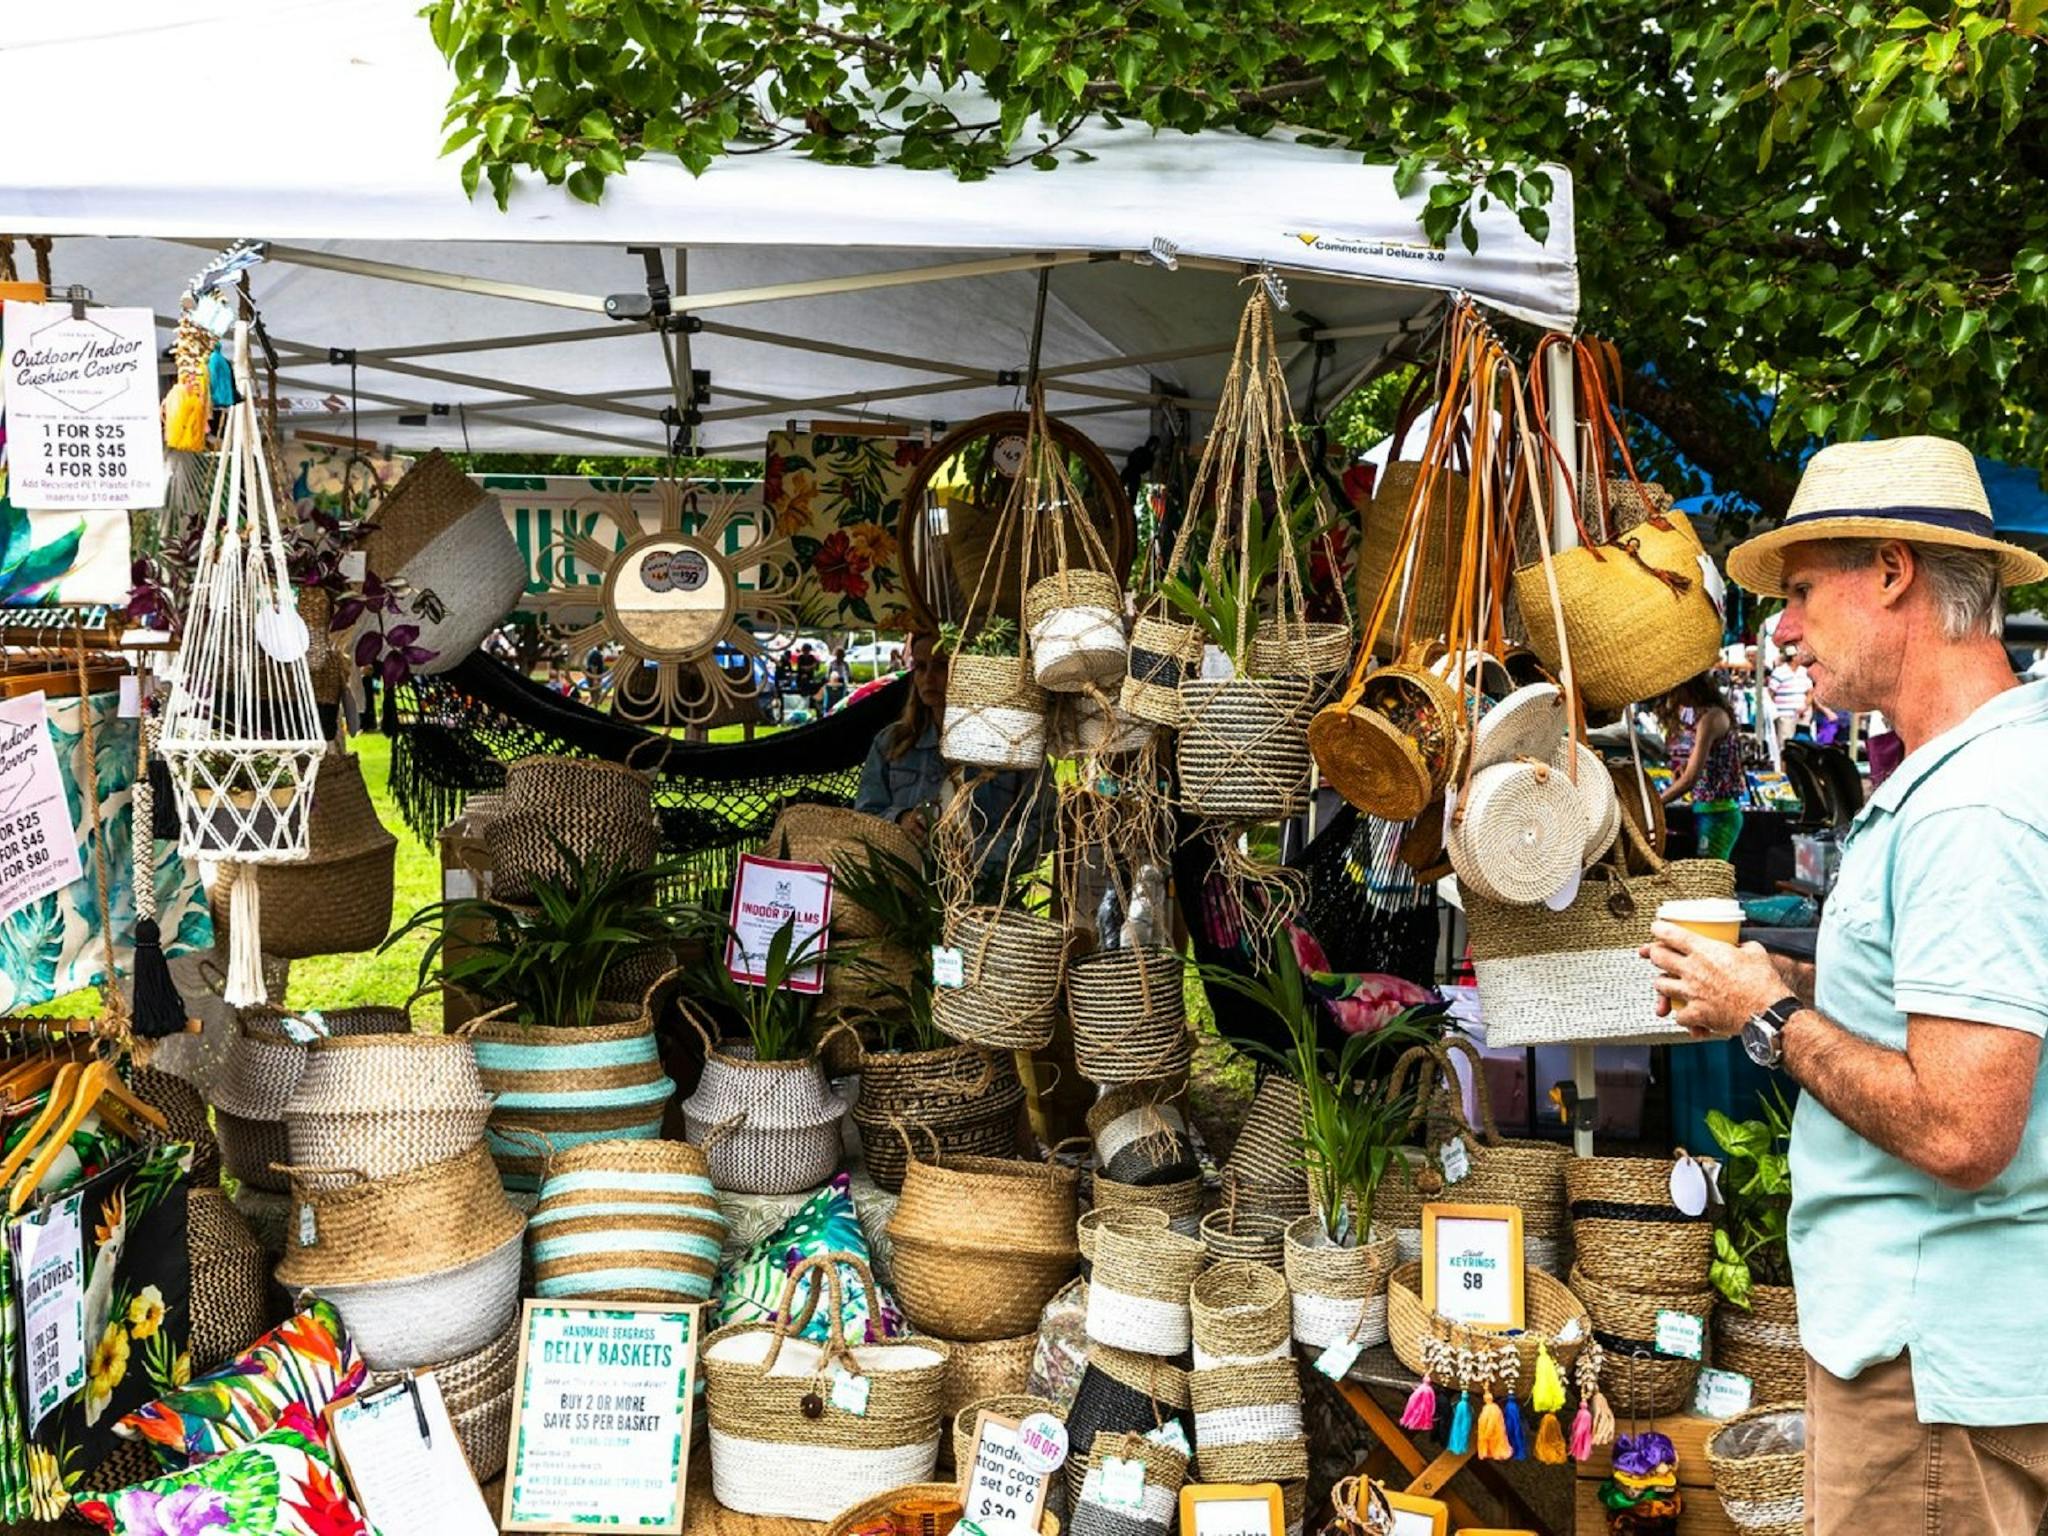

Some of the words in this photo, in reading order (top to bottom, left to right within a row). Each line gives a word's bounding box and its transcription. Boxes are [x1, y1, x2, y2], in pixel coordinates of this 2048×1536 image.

[1315, 241, 1383, 256] Commercial
[1386, 247, 1424, 260] Deluxe
[1427, 251, 1445, 262] 3.0
[12, 340, 142, 368] Outdoor/Indoor
[16, 366, 80, 386] Cushion
[84, 359, 138, 379] Covers
[43, 424, 50, 437] 1
[57, 424, 90, 438] FOR
[95, 424, 125, 438] $25
[44, 442, 53, 457] 2
[58, 443, 91, 457] FOR
[97, 443, 126, 458] $45
[45, 462, 54, 477] 4
[60, 462, 92, 477] FOR
[98, 462, 127, 478] $80
[22, 480, 38, 489] Add
[41, 479, 79, 489] Recycled
[100, 480, 129, 489] Plastic
[109, 492, 129, 501] each
[17, 811, 40, 833] $25
[22, 829, 45, 851] $45
[3, 860, 25, 881] FOR
[26, 848, 49, 869] $80
[742, 902, 780, 919] INDOOR
[782, 911, 820, 925] PLMS
[1449, 1256, 1496, 1269] KEYRINGS
[42, 1261, 74, 1293] COVERS
[1463, 1270, 1483, 1290] $8
[563, 1325, 608, 1339] HANDMADE
[612, 1327, 656, 1340] SEAGRASS
[544, 1340, 594, 1365] BELLY
[598, 1343, 672, 1367] BASKETS
[560, 1393, 583, 1410] BUY
[586, 1395, 593, 1410] 2
[596, 1395, 612, 1411] OR
[615, 1396, 646, 1412] MORE
[544, 1412, 571, 1429] SAVE
[593, 1414, 614, 1430] PER
[617, 1415, 660, 1431] BASKET
[1023, 1428, 1042, 1450] $10
[1041, 1439, 1060, 1461] OFF
[1009, 1467, 1041, 1488] coas
[980, 1475, 1001, 1492] set
[1005, 1484, 1022, 1498] of
[1025, 1489, 1034, 1503] 6
